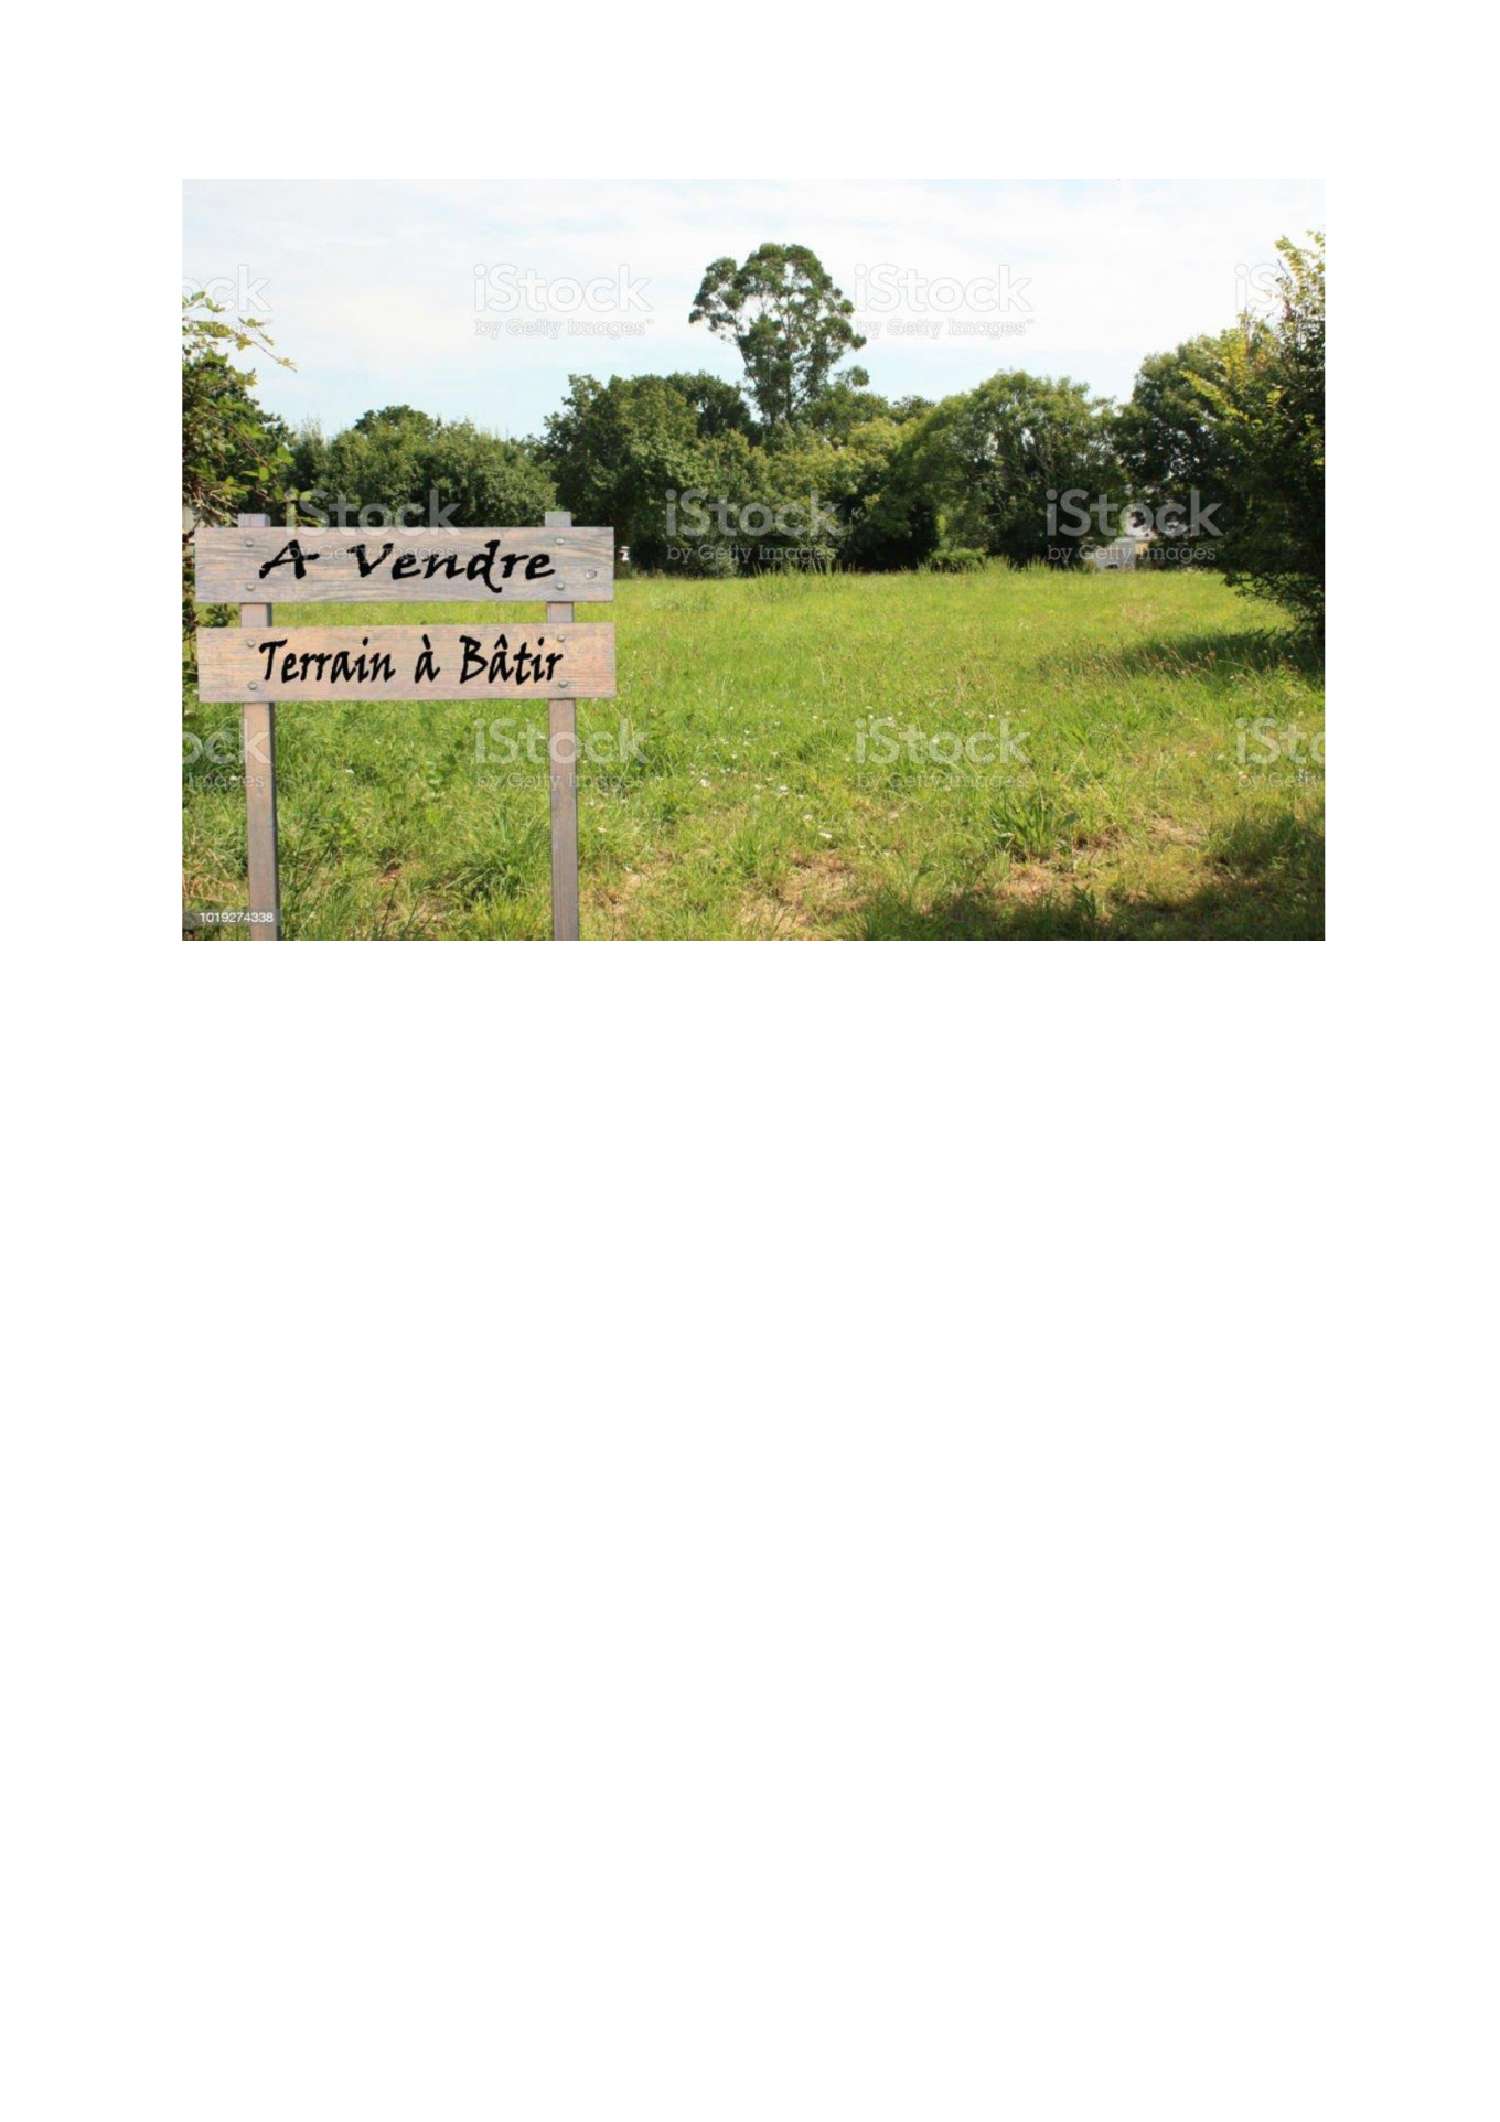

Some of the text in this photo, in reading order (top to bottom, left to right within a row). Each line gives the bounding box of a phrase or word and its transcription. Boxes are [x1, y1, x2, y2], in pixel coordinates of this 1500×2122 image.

[258, 539, 556, 594] A Vendre
[258, 634, 564, 685] Terrain à Bâtir
